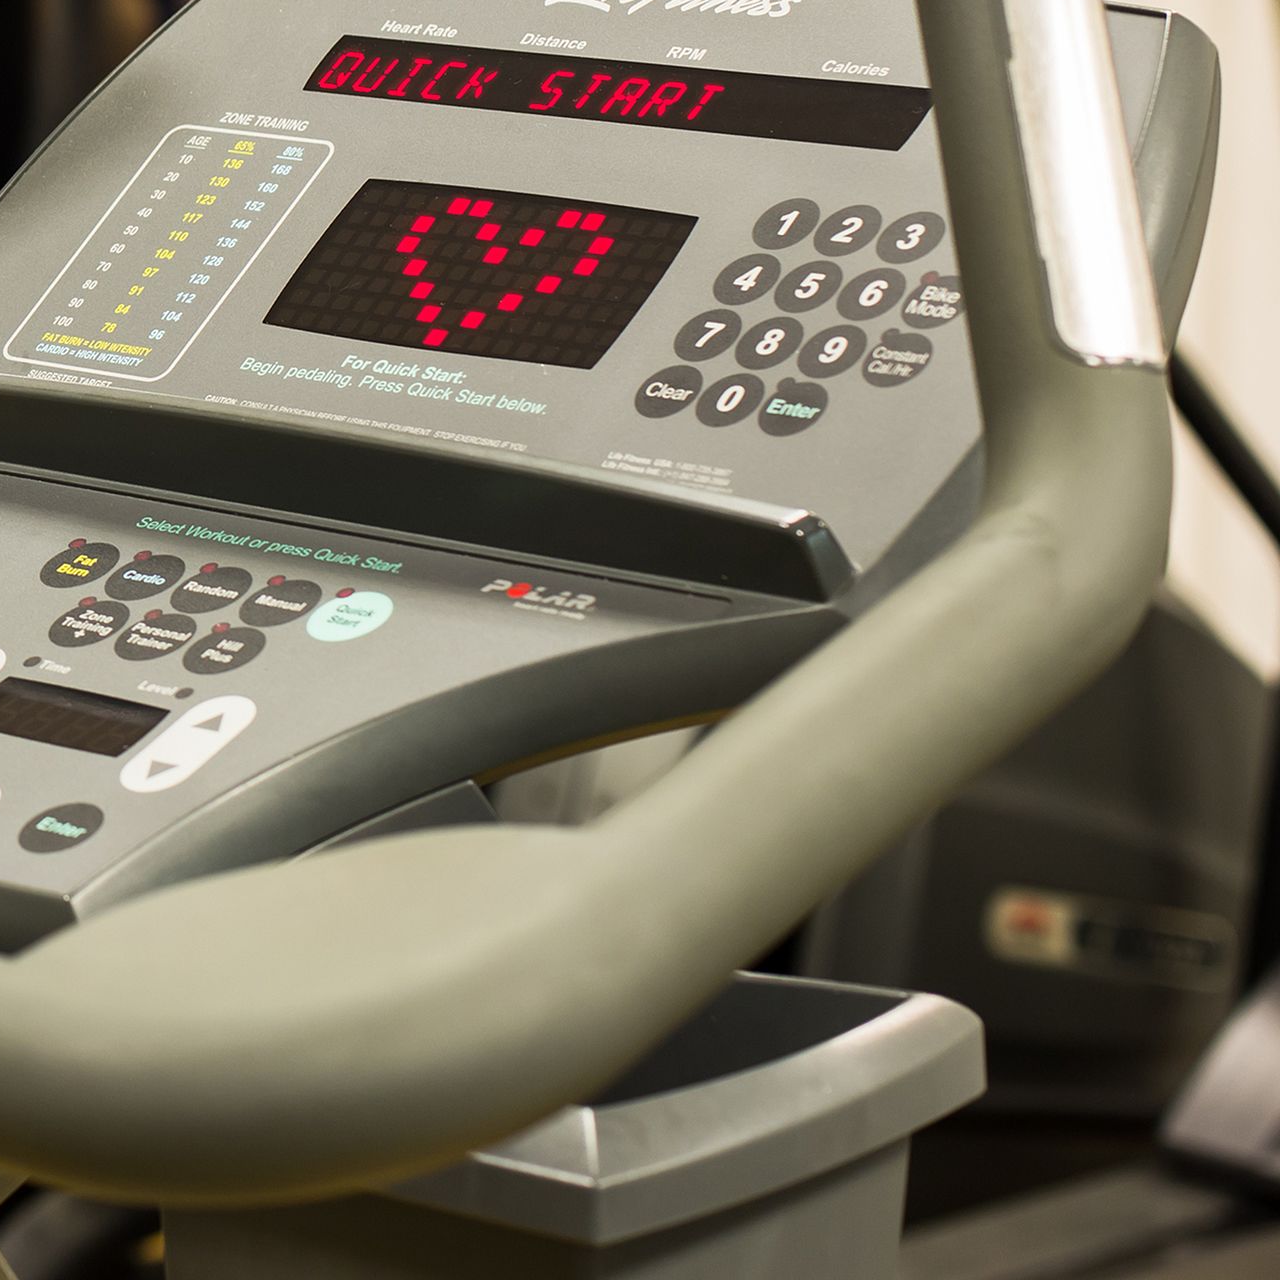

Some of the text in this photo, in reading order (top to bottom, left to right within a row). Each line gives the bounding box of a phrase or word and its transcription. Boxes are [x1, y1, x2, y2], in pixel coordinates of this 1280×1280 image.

[381, 20, 459, 39] Heart Rate
[520, 33, 587, 51] Distance
[666, 46, 707, 62] RPM
[821, 59, 890, 79] Calories
[317, 51, 725, 121] QUICK START
[219, 112, 309, 132] ZONE TRAINING
[187, 135, 211, 147] AGE
[179, 154, 292, 175] 10 136 168
[163, 172, 278, 194] 20 130 160
[150, 189, 265, 212] 30 123 152
[137, 208, 252, 230] 40 117 144
[123, 225, 238, 248] 50 110 136
[777, 210, 926, 250] 1 2 3
[110, 243, 224, 267] 60 104 128
[96, 261, 210, 285] 70 97 120
[82, 279, 196, 304] 80 91 112
[733, 266, 888, 307] 4 5 6
[920, 285, 961, 304] Bike
[68, 298, 183, 322] 90 84 104
[905, 299, 957, 319] Mode
[52, 316, 165, 340] 100 78 96
[41, 332, 60, 343] FAT
[60, 335, 83, 346] BURN
[88, 339, 110, 350] LOW
[109, 343, 152, 357] INTENSITY
[695, 322, 848, 363] 7 8 9
[36, 343, 69, 355] CARDIO
[75, 349, 97, 360] HIGH
[97, 352, 143, 367] INTENSITY
[341, 355, 467, 384] For Quick Start:
[240, 357, 547, 415] Begin pedaling. Press Quick Start below.
[645, 382, 821, 420] Clear 0 Enter
[136, 517, 184, 535] Select
[185, 524, 248, 546] Workout
[249, 539, 267, 549] or
[264, 542, 312, 557] press
[314, 548, 361, 566] Quick
[56, 563, 89, 577] Burn
[73, 554, 98, 567] Fat
[123, 570, 166, 585] Cardio
[183, 581, 239, 600] Random
[255, 594, 308, 612] Manual
[336, 604, 375, 618] Quick
[61, 616, 113, 636] Training
[79, 609, 114, 624] Zone
[326, 615, 361, 628] Start
[126, 633, 173, 650] Trainer
[131, 622, 192, 641] Personal
[216, 639, 245, 652] Hill
[200, 649, 234, 663] Plus
[39, 659, 71, 674] Time
[137, 680, 179, 698] Level
[35, 816, 88, 839] Enter
